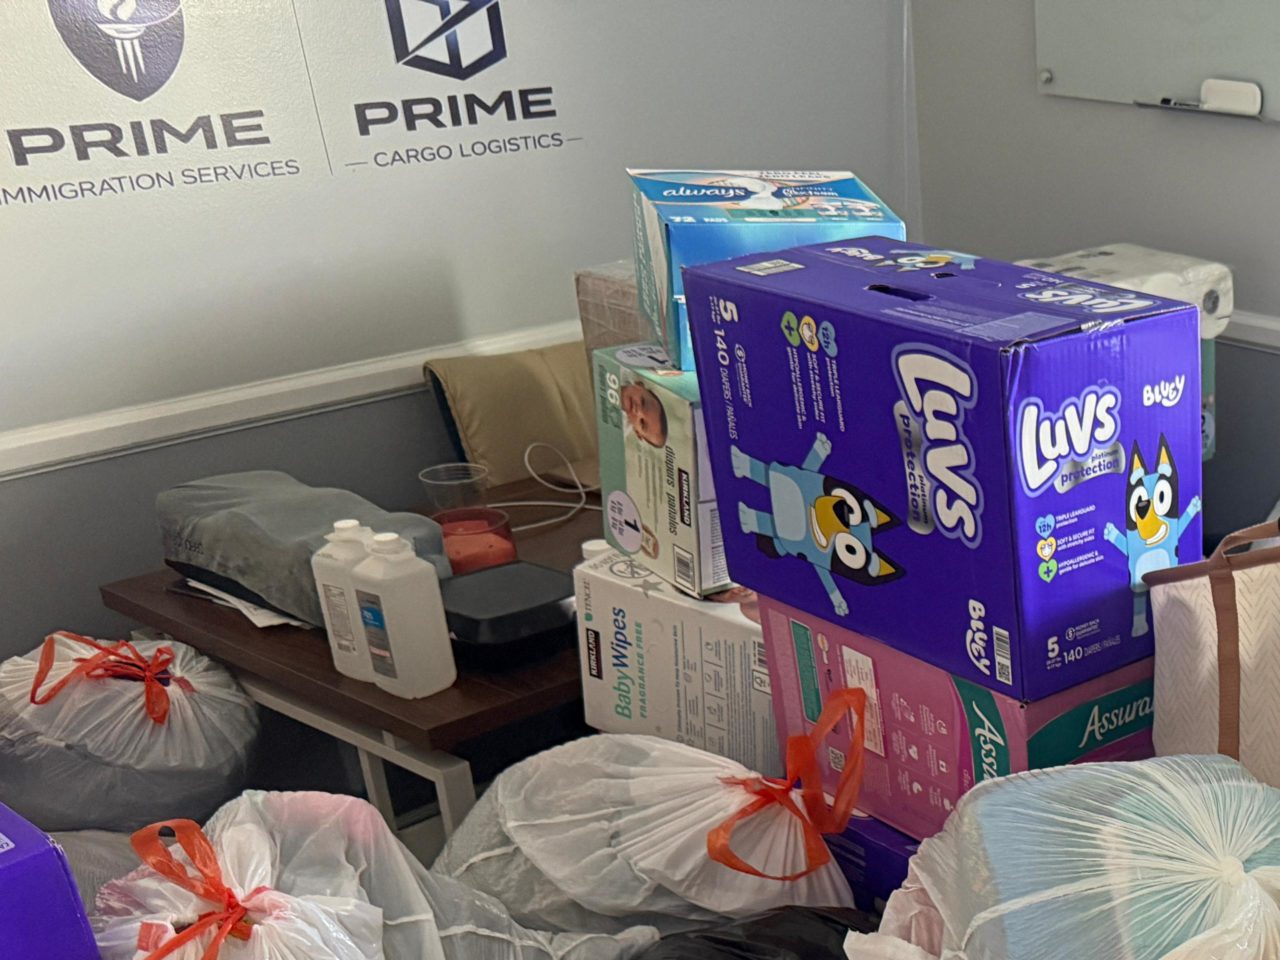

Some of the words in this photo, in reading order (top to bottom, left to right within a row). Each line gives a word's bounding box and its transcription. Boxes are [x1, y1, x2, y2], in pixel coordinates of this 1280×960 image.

[354, 86, 557, 136] PRIME
[7, 110, 270, 166] PRIME
[373, 146, 454, 168] CARGO
[458, 132, 564, 158] LOGISTICS
[0, 171, 174, 205] MMIGRATION
[181, 159, 300, 186] SERVICES
[663, 186, 746, 198] always
[719, 297, 739, 324] 5
[714, 328, 730, 367] 140
[604, 371, 621, 407] 96
[720, 367, 732, 400] DIAPERS
[663, 445, 678, 489] diapers
[899, 412, 921, 533] protection
[1060, 457, 1120, 486] protection
[678, 472, 692, 525] KIRKLAND
[588, 630, 598, 676] KIRKLAND
[635, 621, 644, 649] FREE
[1047, 635, 1059, 658] 5
[1063, 646, 1083, 664] 140
[636, 653, 647, 718] FRAGRANCE
[1078, 700, 1154, 749] Assura
